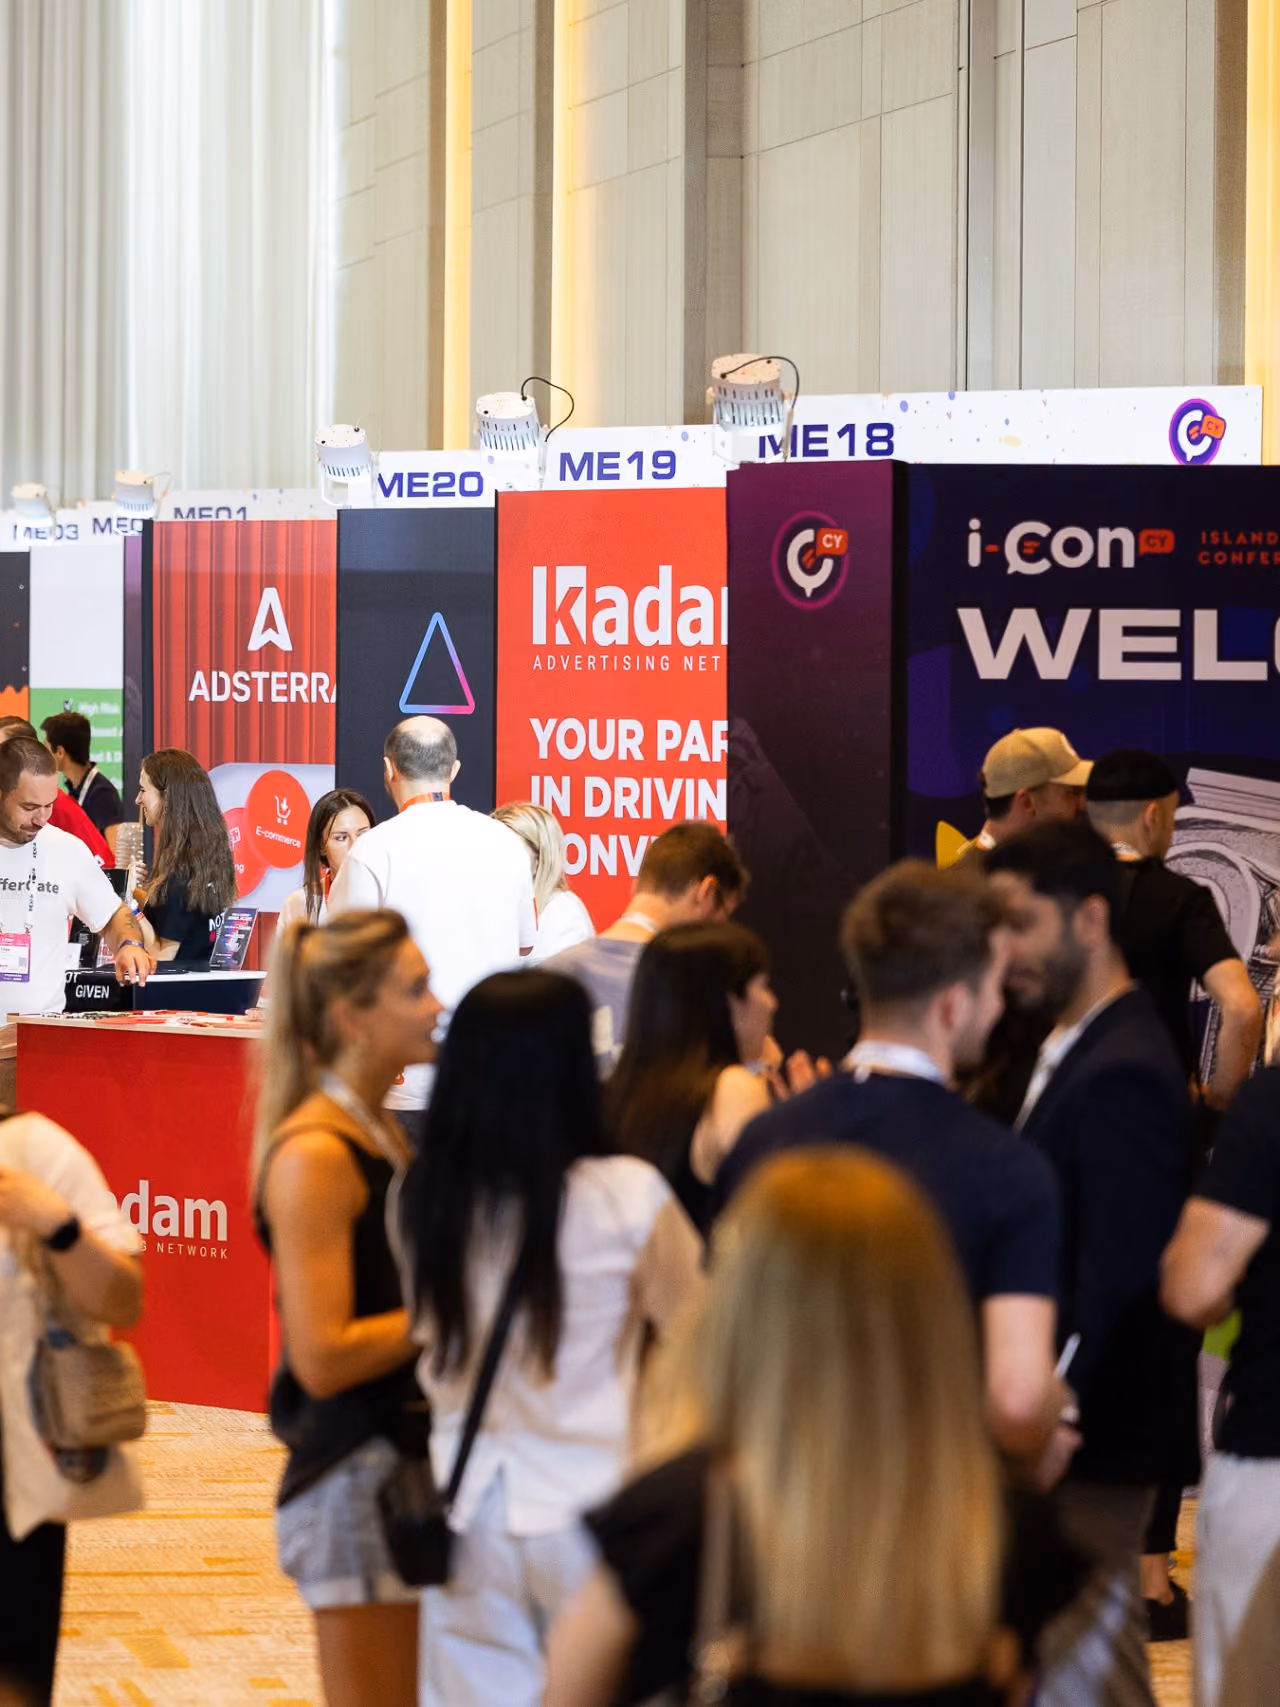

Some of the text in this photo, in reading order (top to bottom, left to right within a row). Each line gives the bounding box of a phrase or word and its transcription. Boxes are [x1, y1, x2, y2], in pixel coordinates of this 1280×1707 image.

[759, 423, 895, 458] ME18
[560, 450, 676, 481] ME19
[378, 471, 484, 498] ME20
[822, 534, 843, 548] CY
[968, 518, 1167, 575] i-Con CY
[1201, 530, 1279, 545] ISLAND
[532, 565, 728, 646] Kada
[957, 608, 1280, 681] WEL
[533, 655, 721, 672] ADVERTISING NET
[529, 717, 645, 760] YOUR
[531, 775, 727, 821] IN DRIVIN
[255, 825, 302, 848] E-commerce
[563, 833, 662, 877] ONV
[76, 985, 110, 999] GIVEN
[108, 1179, 228, 1242] dam
[156, 1242, 228, 1259] NETWORK
